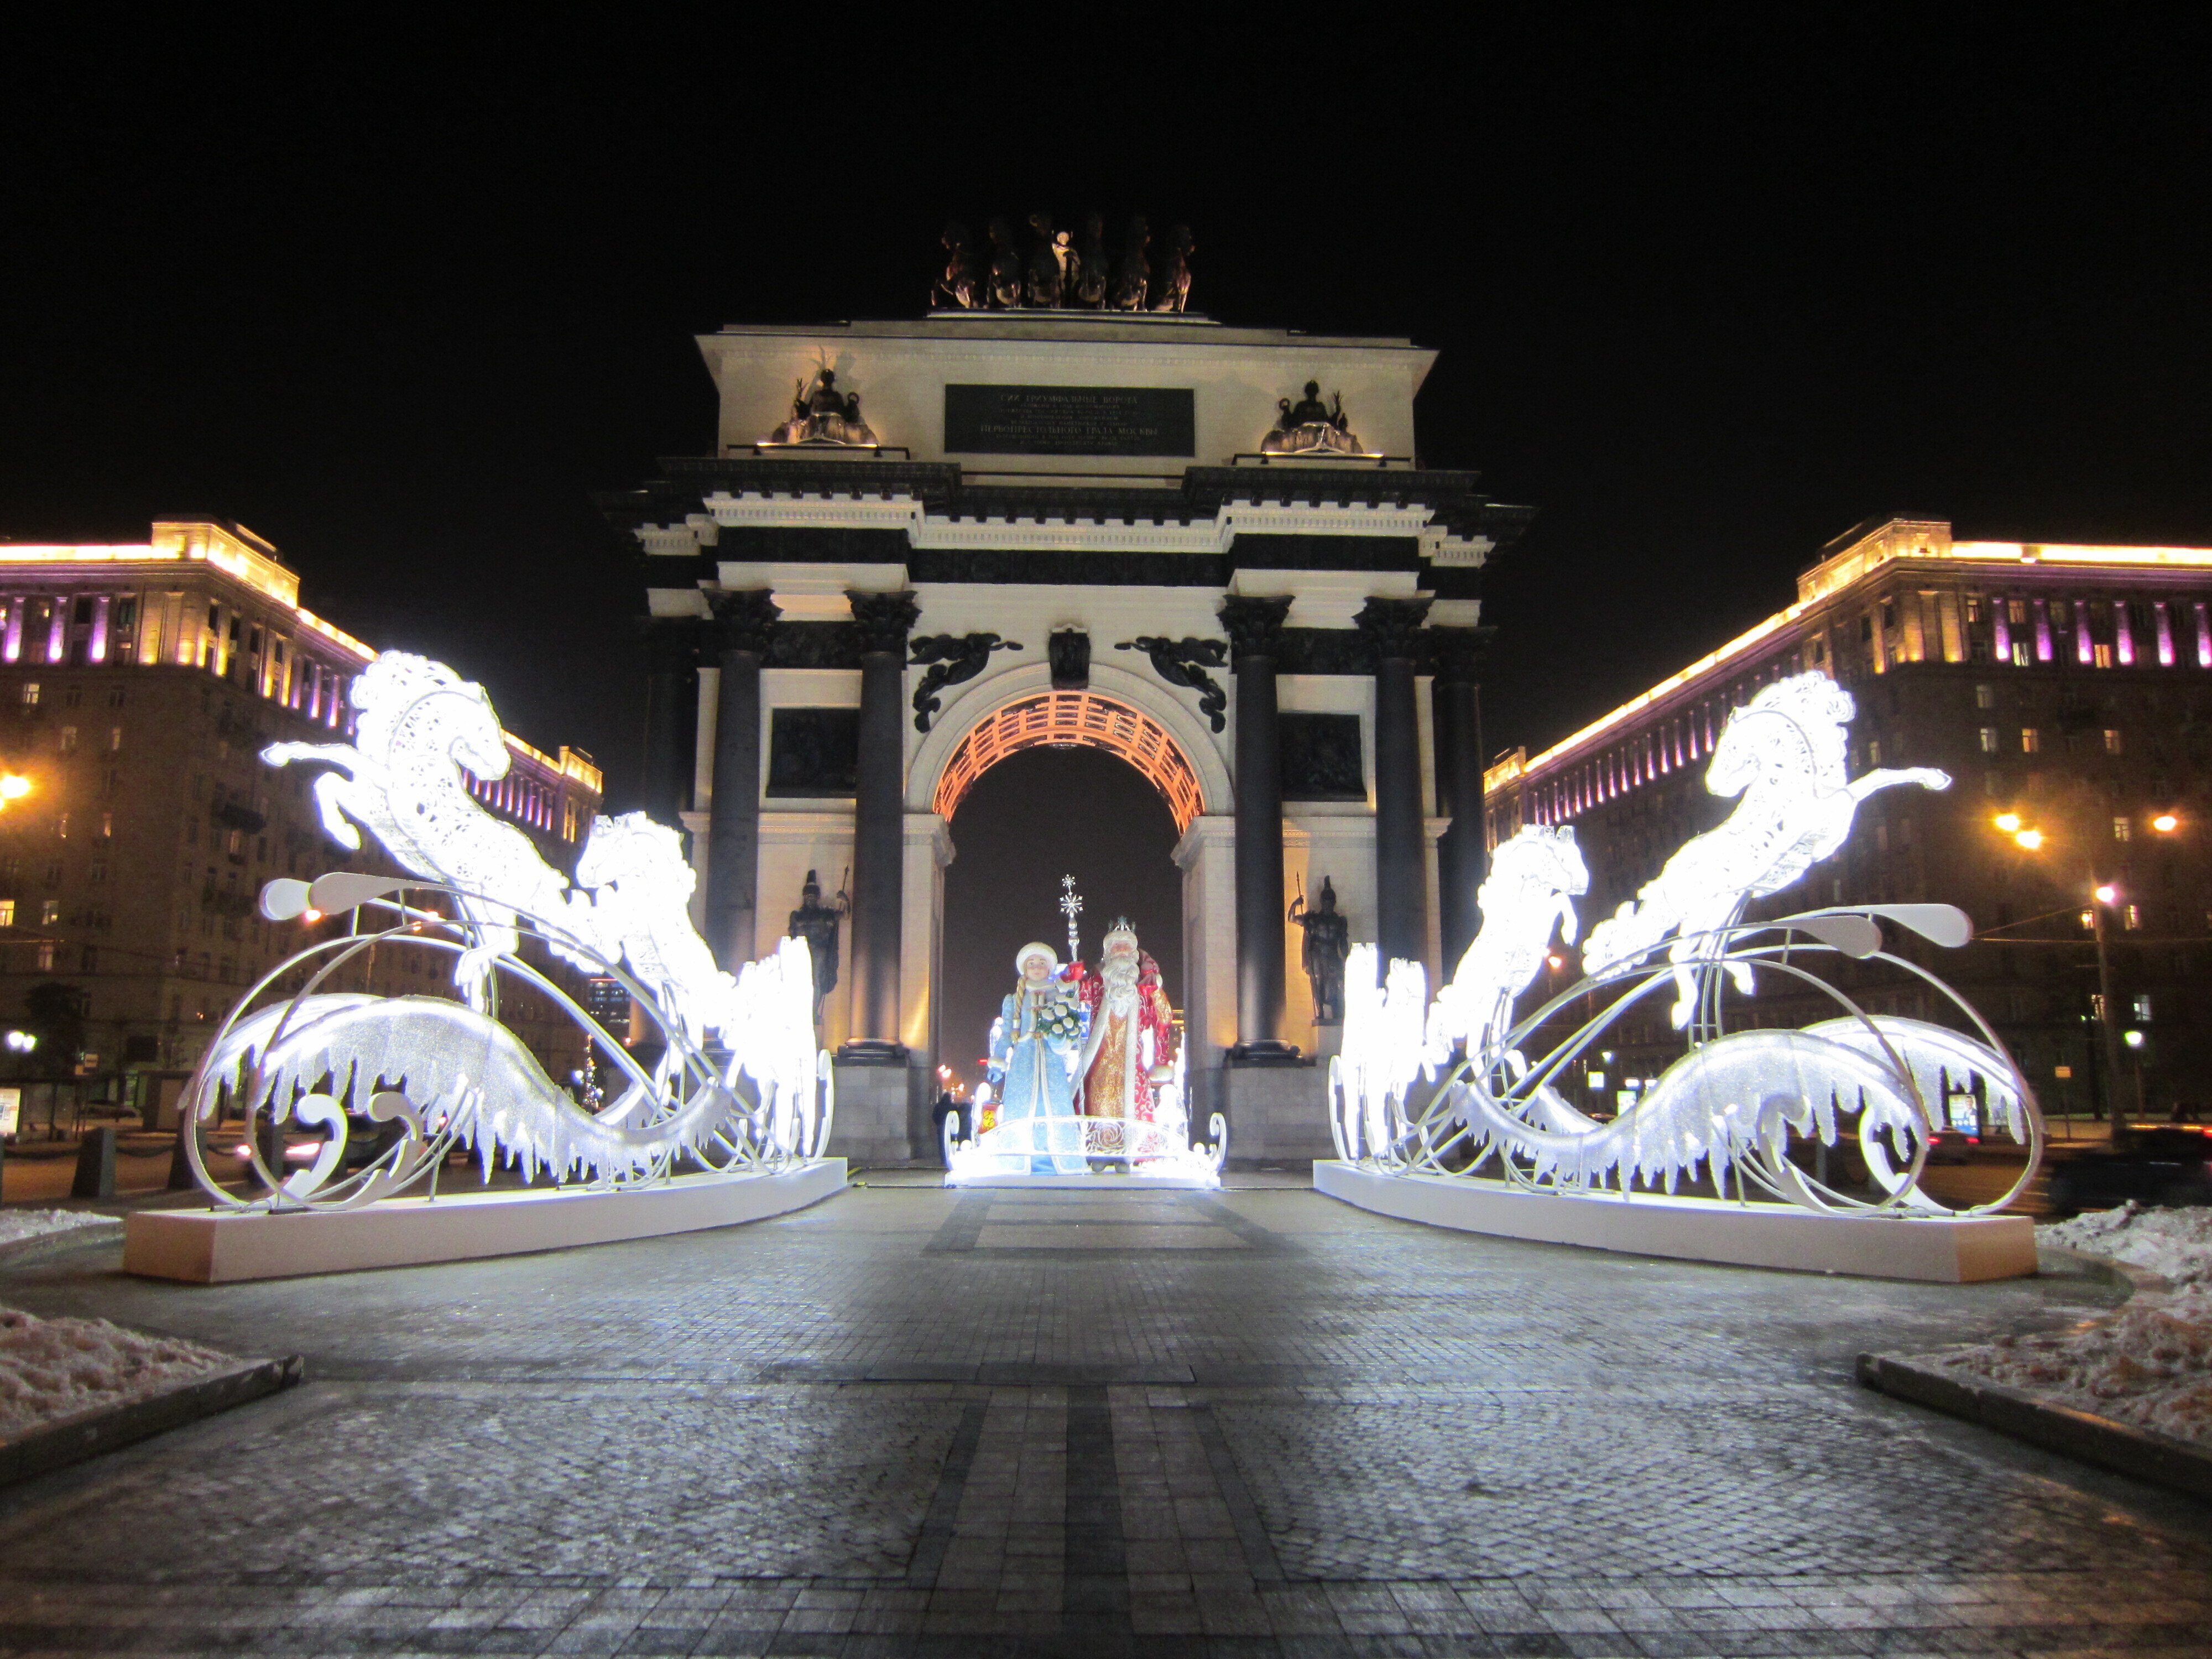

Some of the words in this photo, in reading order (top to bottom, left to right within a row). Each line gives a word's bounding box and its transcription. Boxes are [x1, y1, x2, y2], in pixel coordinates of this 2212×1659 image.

[1026, 395, 1097, 403] ТРИУМФАЛЬНЫЕ
[1103, 396, 1138, 404] ВОРОТА
[980, 425, 1082, 434] ПЕРВОПРЕСТОЛЬНОГО
[1086, 426, 1113, 435] ГРАДА
[1118, 427, 1158, 435] МОСКВЫ
